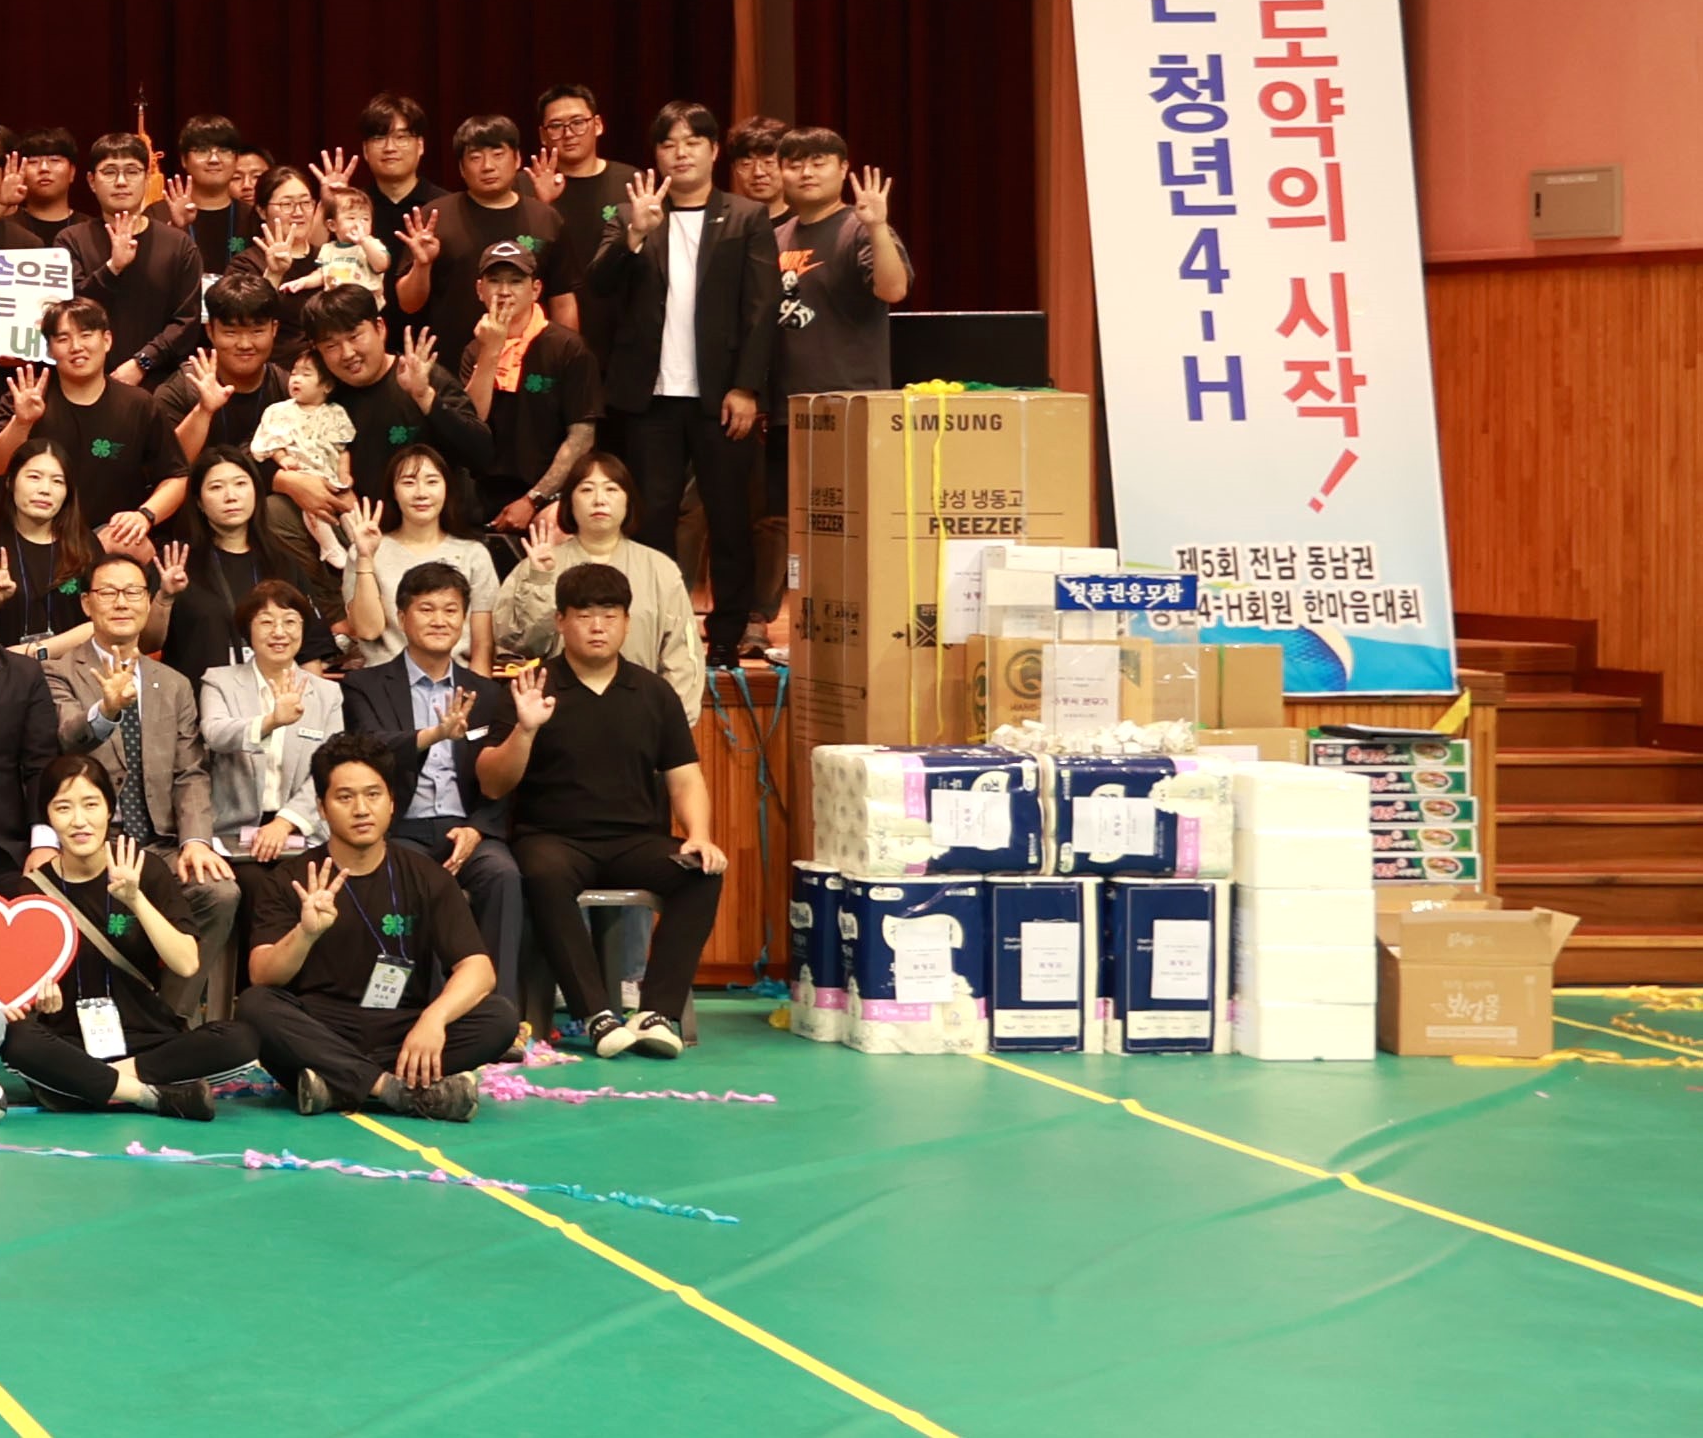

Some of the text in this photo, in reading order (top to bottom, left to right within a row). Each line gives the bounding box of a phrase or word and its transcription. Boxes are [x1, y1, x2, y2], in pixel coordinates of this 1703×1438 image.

[1148, 53, 1248, 424] 청년4-H
[10, 326, 42, 359] 내
[1275, 271, 1367, 515] 시작!
[891, 413, 1003, 432] SAMSUNG
[972, 488, 1025, 509] 냉동고
[929, 517, 1026, 535] FREEZER
[1177, 545, 1375, 582] 제5회 전남 동남권
[1302, 587, 1424, 627] 한마음대회
